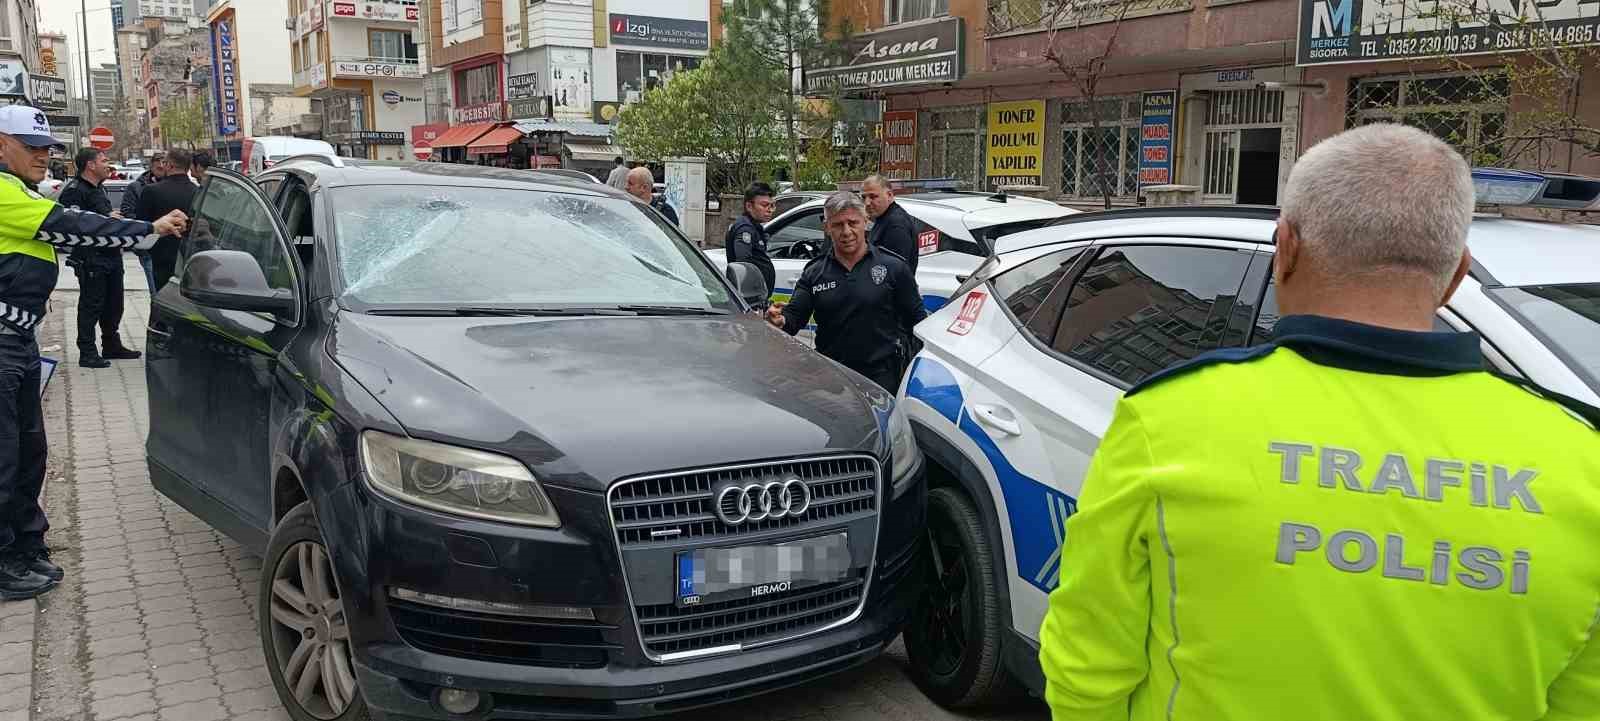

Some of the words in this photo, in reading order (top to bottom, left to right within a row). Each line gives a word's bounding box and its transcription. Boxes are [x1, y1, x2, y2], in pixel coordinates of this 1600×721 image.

[1311, 38, 1349, 48] MERKEZ
[1360, 41, 1378, 56] TEL
[1419, 36, 1441, 53] 230
[1443, 34, 1459, 52] 00
[1461, 34, 1477, 50] 33
[1566, 24, 1593, 43] 865
[850, 37, 939, 65] Asena
[1310, 48, 1349, 58] SİGORTA
[838, 71, 868, 87] TONER
[871, 67, 903, 83] DOLUM
[906, 60, 951, 79] MERKEZİ
[1145, 96, 1171, 105] ASENA
[998, 109, 1035, 123] TONER
[991, 132, 1038, 147] DOLUMU
[992, 156, 1036, 169] YAPILIR
[919, 233, 936, 247] 112
[751, 582, 791, 596] HERMOT
